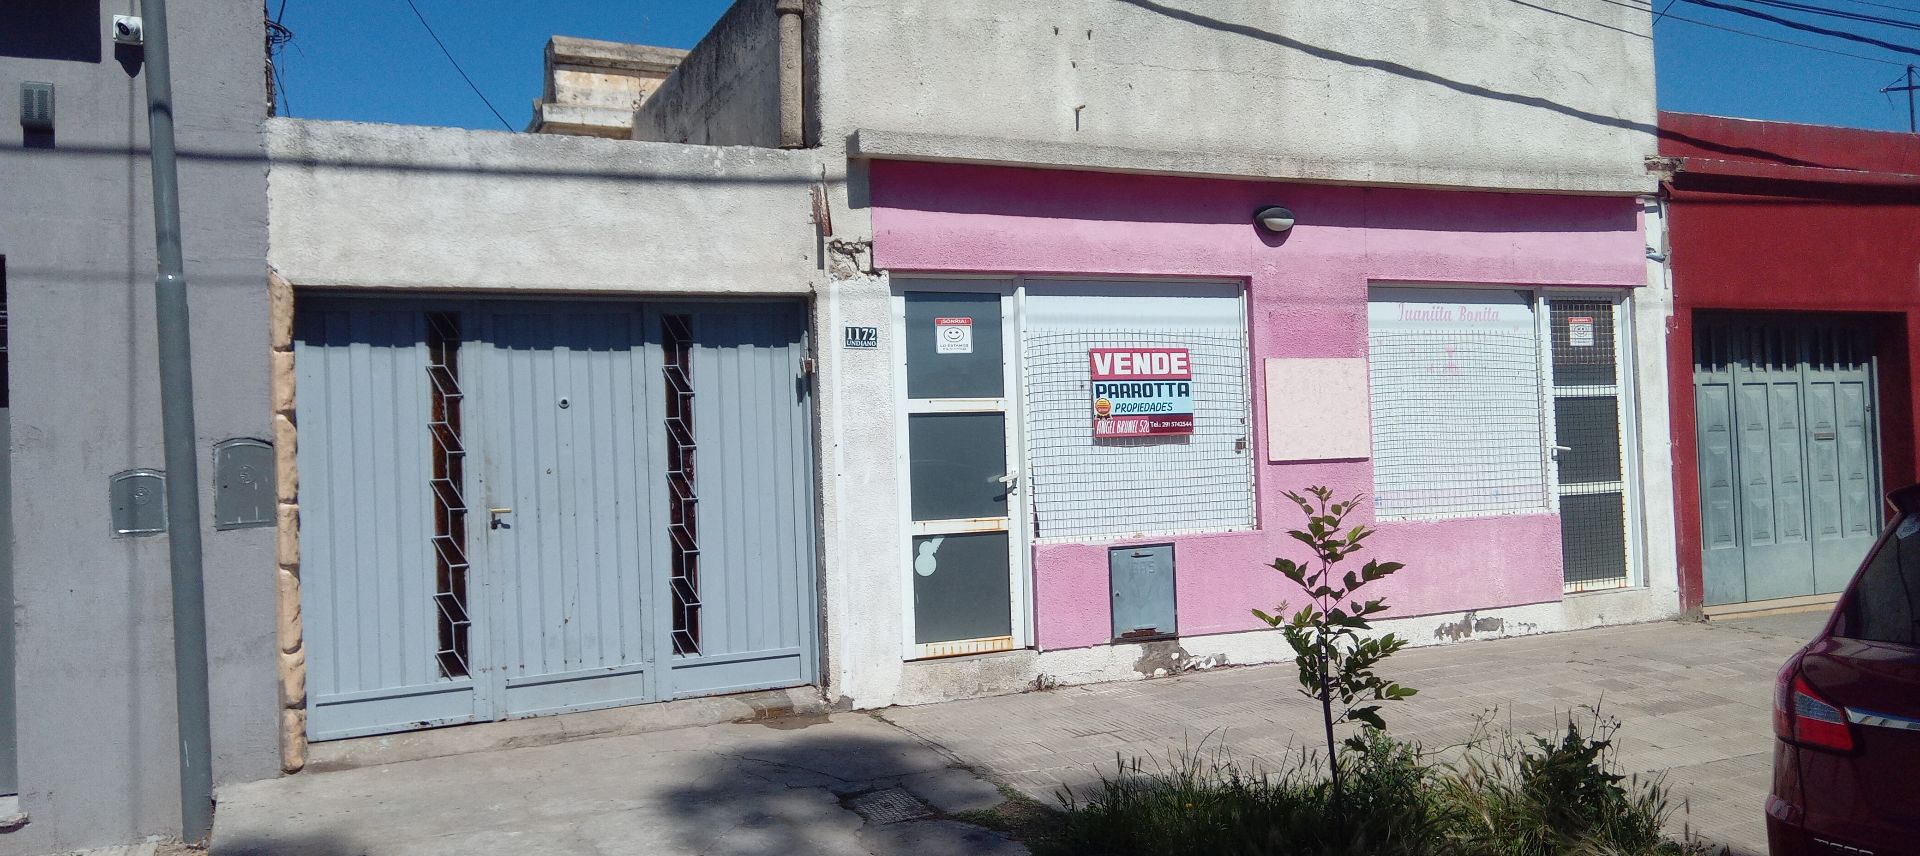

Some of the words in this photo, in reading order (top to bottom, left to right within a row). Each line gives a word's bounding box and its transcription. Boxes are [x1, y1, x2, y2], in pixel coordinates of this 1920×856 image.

[1459, 305, 1500, 322] Bonita
[847, 327, 877, 341] 1172
[1093, 352, 1188, 375] VENDE
[1095, 382, 1190, 399] PARROTTA
[1114, 402, 1173, 413] PROPIEDADES
[1096, 420, 1116, 435] ANGEL
